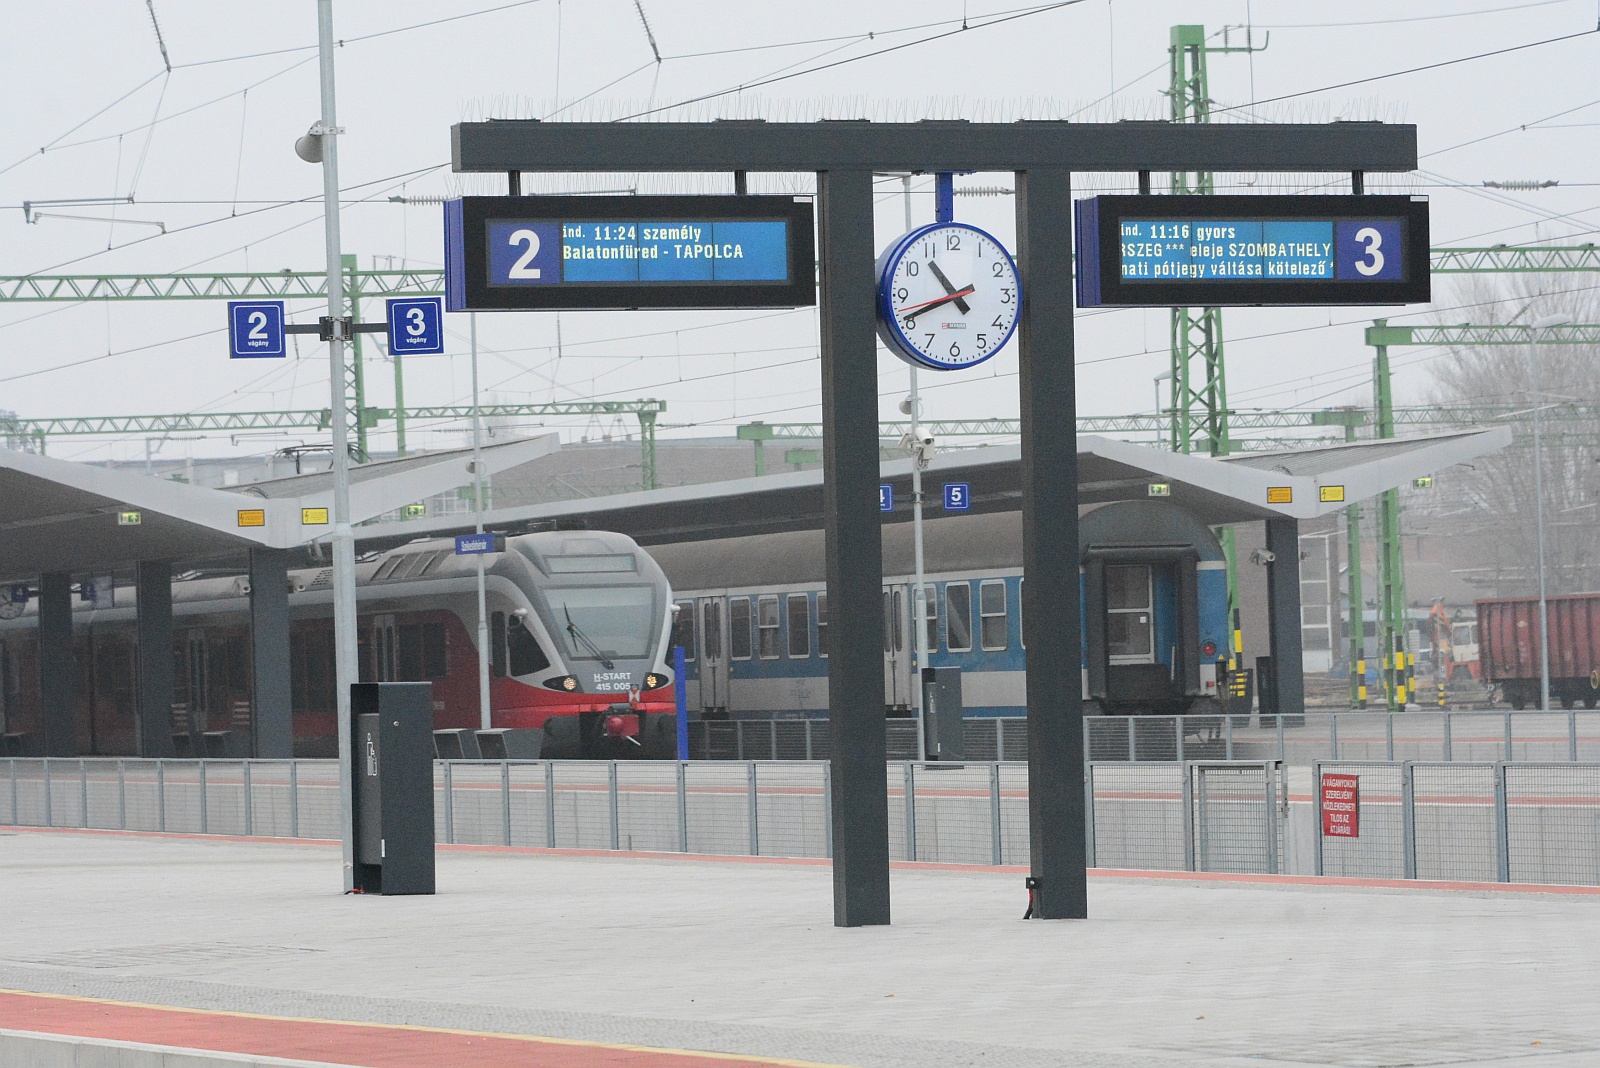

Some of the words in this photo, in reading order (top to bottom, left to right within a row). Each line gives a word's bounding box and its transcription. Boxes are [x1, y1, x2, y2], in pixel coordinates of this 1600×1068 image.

[563, 225, 586, 238] ind.
[594, 226, 636, 240] 11:24
[643, 224, 701, 242] személy
[1121, 224, 1142, 236] ind.
[1150, 224, 1189, 239] 11:16
[1196, 227, 1235, 241] gyors
[924, 242, 935, 258] 11
[946, 235, 961, 251] 12
[1190, 243, 1223, 259] eleje
[1228, 243, 1331, 257] SZOMBATHELY
[508, 229, 541, 279] 2
[563, 244, 658, 259] Balatonfüred
[674, 244, 743, 259] TAPOLCA
[1354, 227, 1385, 277] 3
[906, 261, 919, 276] 10
[992, 262, 1004, 277] 2
[1154, 260, 1205, 278] pótjegy
[1210, 260, 1263, 276] váltása
[1268, 260, 1326, 276] kötelező
[897, 288, 909, 303] 9
[1000, 288, 1011, 304] 3
[248, 311, 268, 339] 2
[406, 308, 426, 336] 3
[905, 316, 916, 330] 8
[991, 315, 1003, 330] 4
[924, 333, 936, 349] 7
[976, 333, 987, 349] 5
[950, 342, 961, 357] 6
[951, 487, 962, 502] 5
[593, 672, 631, 682] H-START
[596, 682, 611, 691] 415
[613, 682, 631, 690] 005
